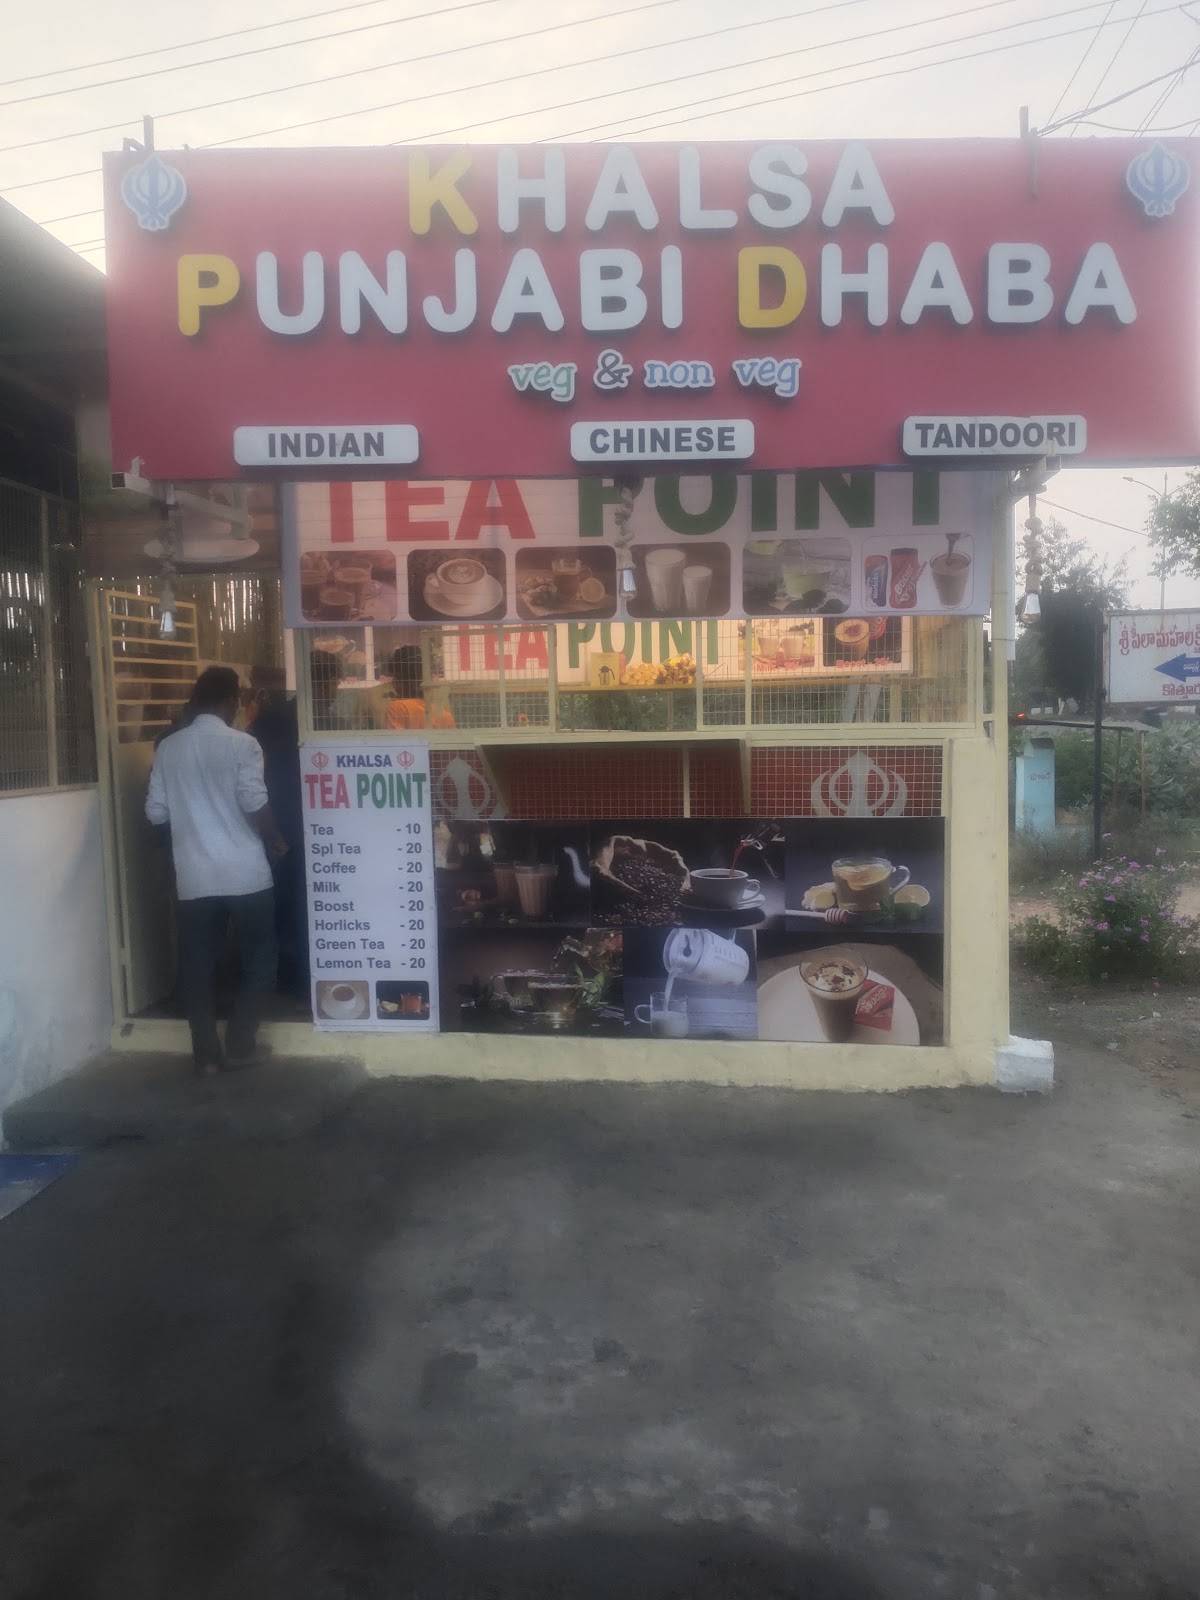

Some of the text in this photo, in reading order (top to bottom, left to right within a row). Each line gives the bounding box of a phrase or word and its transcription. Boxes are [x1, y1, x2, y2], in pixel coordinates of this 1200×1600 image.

[409, 142, 895, 235] KHALSA
[177, 242, 1137, 336] PUNJABI DHABA
[509, 350, 801, 400] veg & non veg
[589, 426, 736, 454] CHINESE
[915, 422, 1076, 448] TANDOORI
[268, 432, 385, 458] INDIAN
[336, 755, 393, 768] KHALSA
[304, 773, 427, 809] TEA POINT
[310, 824, 334, 835] Tea
[311, 843, 333, 857] Spl
[337, 843, 361, 854] Tea
[312, 862, 356, 873] Coffee
[313, 881, 340, 892] Milk
[314, 900, 355, 911] Boost
[315, 920, 370, 931] Horlicks
[315, 939, 356, 950] Green
[360, 939, 385, 950] Tea
[316, 958, 362, 968] Lemon
[366, 957, 391, 968] Tea
